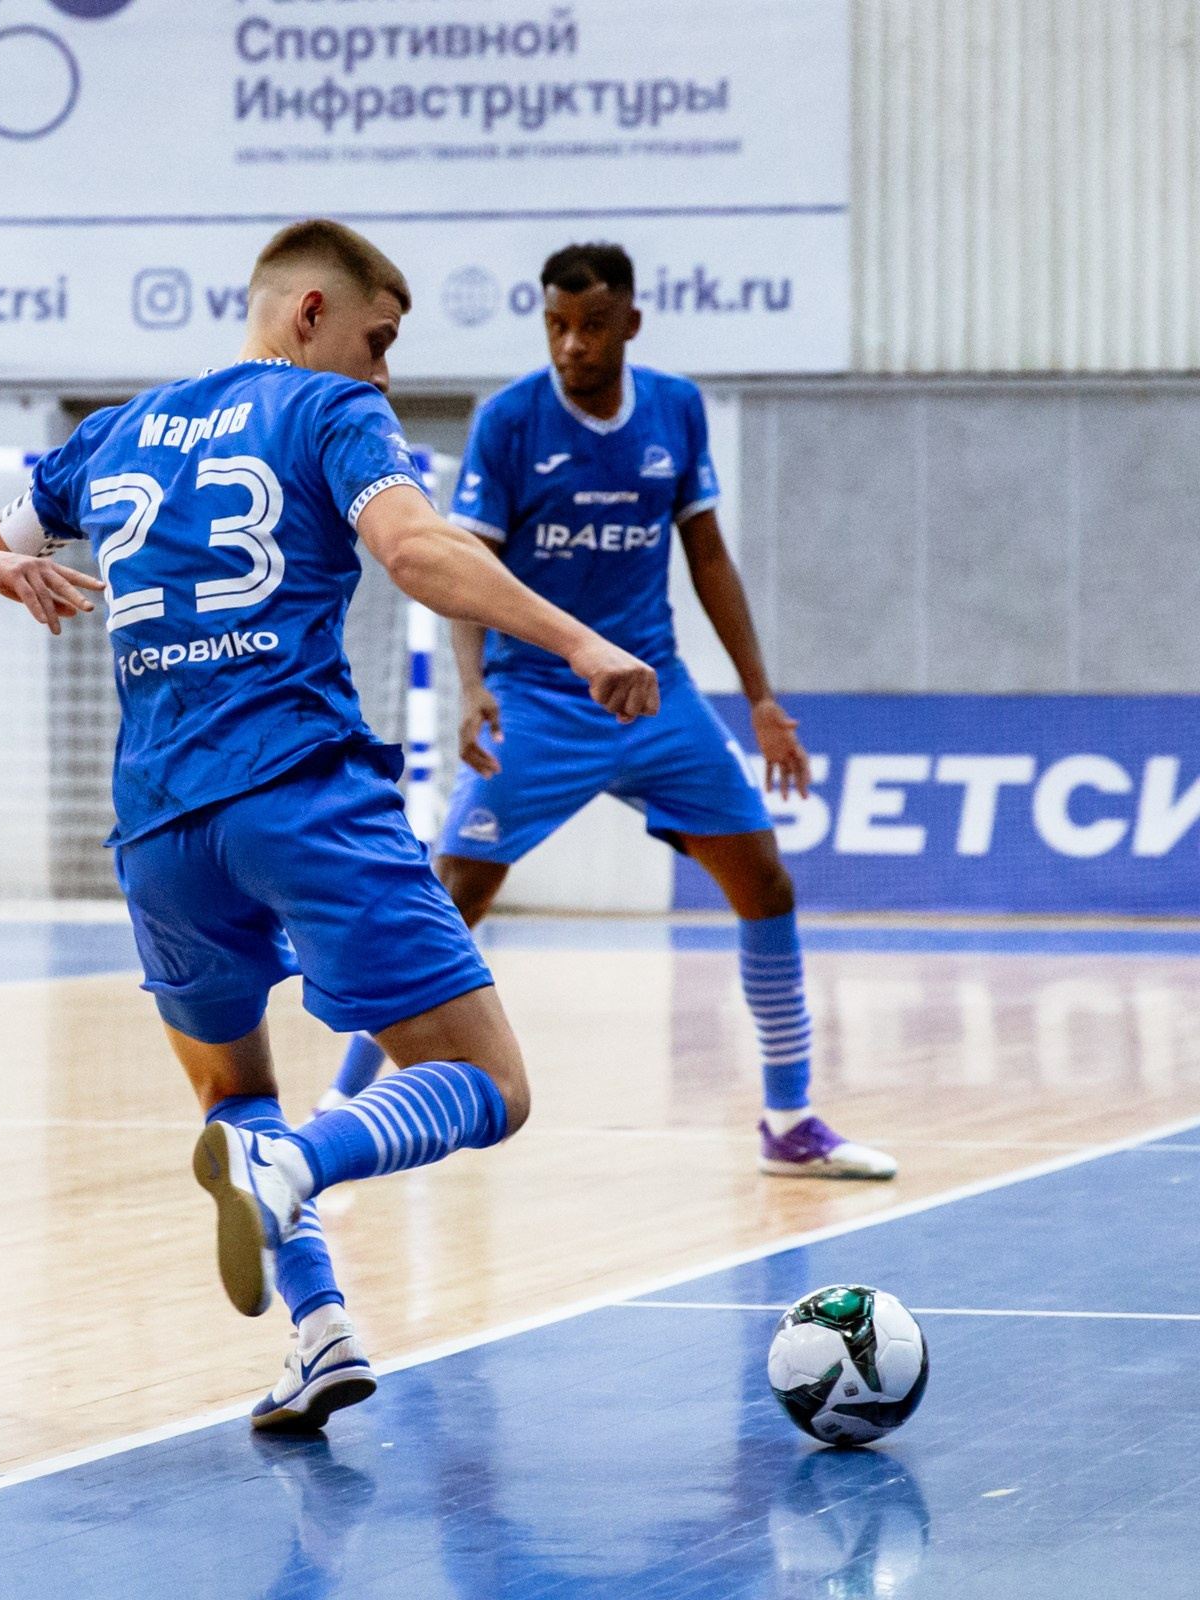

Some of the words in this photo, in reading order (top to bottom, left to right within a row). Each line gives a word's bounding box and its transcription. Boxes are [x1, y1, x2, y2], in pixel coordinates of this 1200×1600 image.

[234, 8, 579, 74] Спортивной
[234, 77, 730, 133] Инфраструктуры
[90, 455, 285, 633] 23
[535, 523, 662, 551] IRAERO
